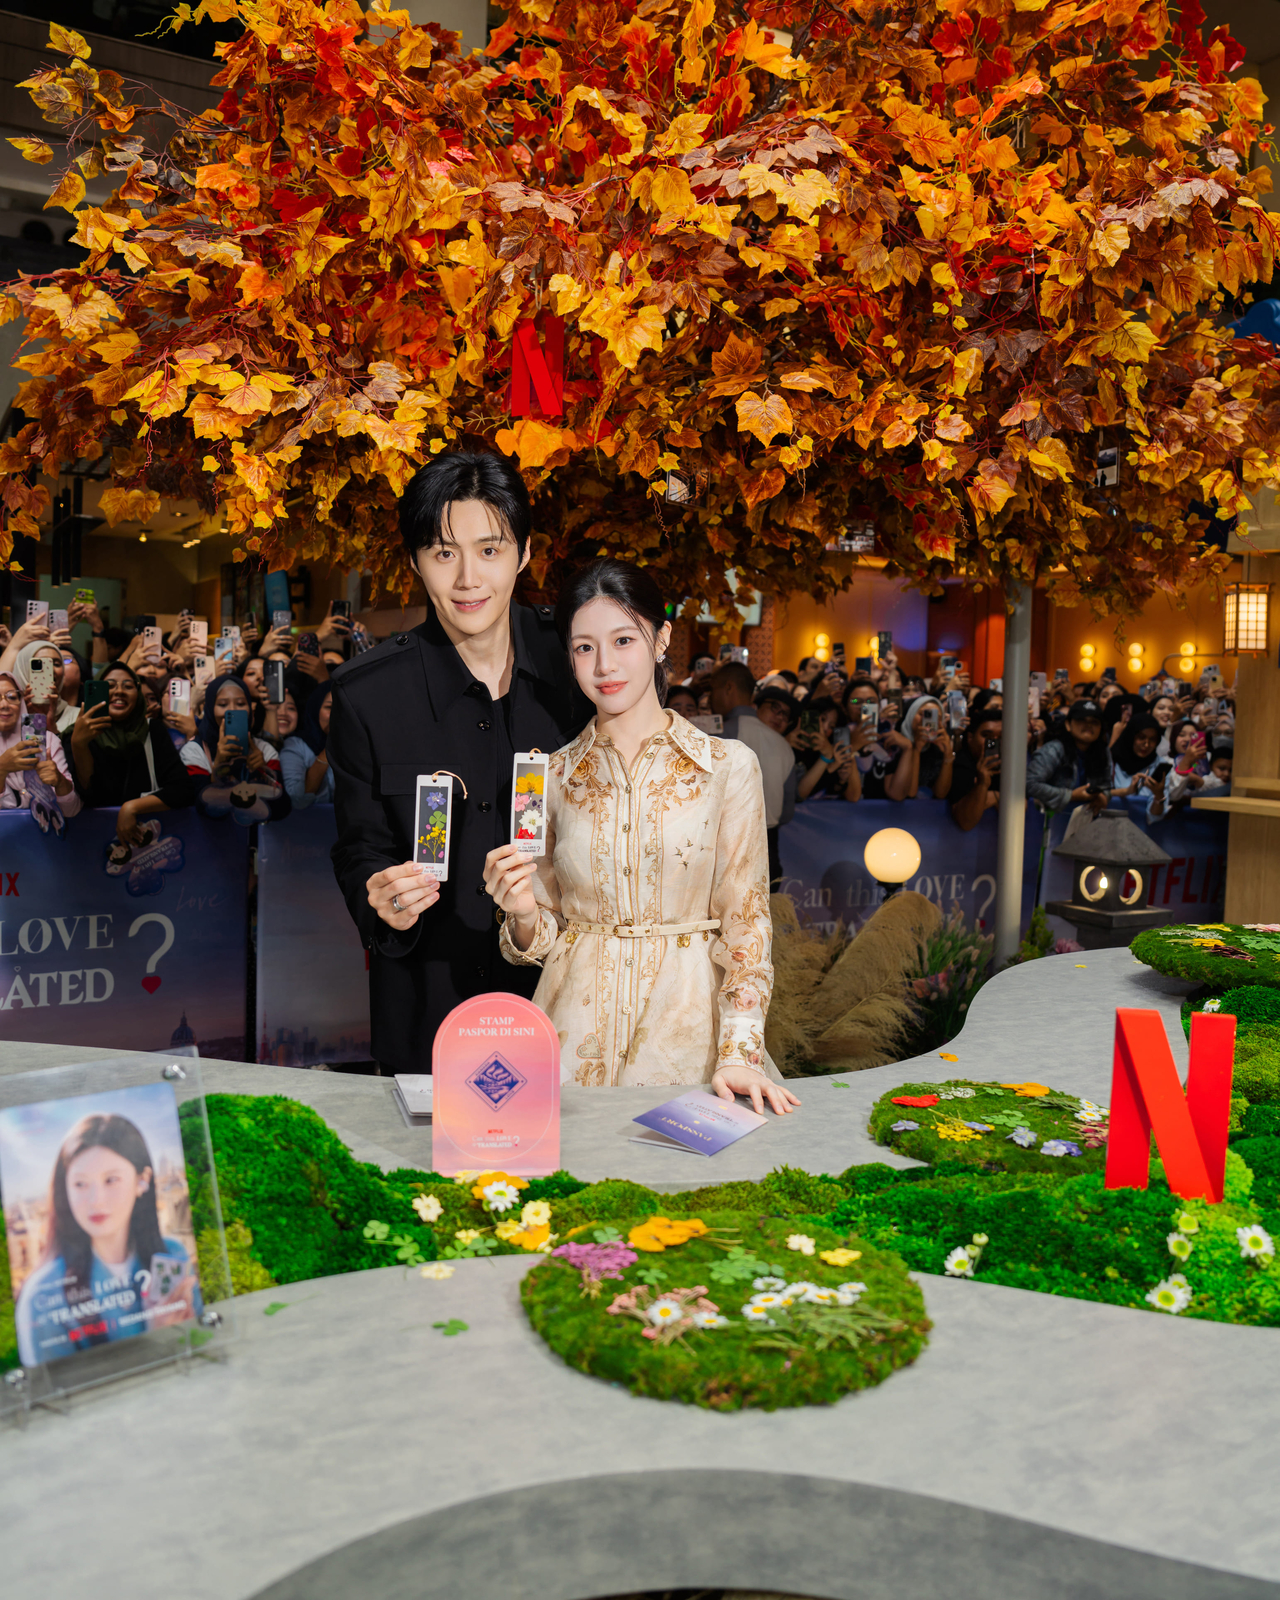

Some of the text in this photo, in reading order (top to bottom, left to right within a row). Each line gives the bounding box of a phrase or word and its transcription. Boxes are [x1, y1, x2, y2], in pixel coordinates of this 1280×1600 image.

[511, 316, 564, 417] N
[783, 879, 832, 909] Can
[1123, 855, 1226, 906] TFLIX
[175, 885, 228, 912] Love
[458, 1027, 535, 1037] PASPOR DI SINI
[479, 1016, 515, 1026] STAMP
[1105, 1007, 1237, 1205] N
[658, 1116, 713, 1142] PASSPORT
[50, 1289, 136, 1326] TRANSLATED
